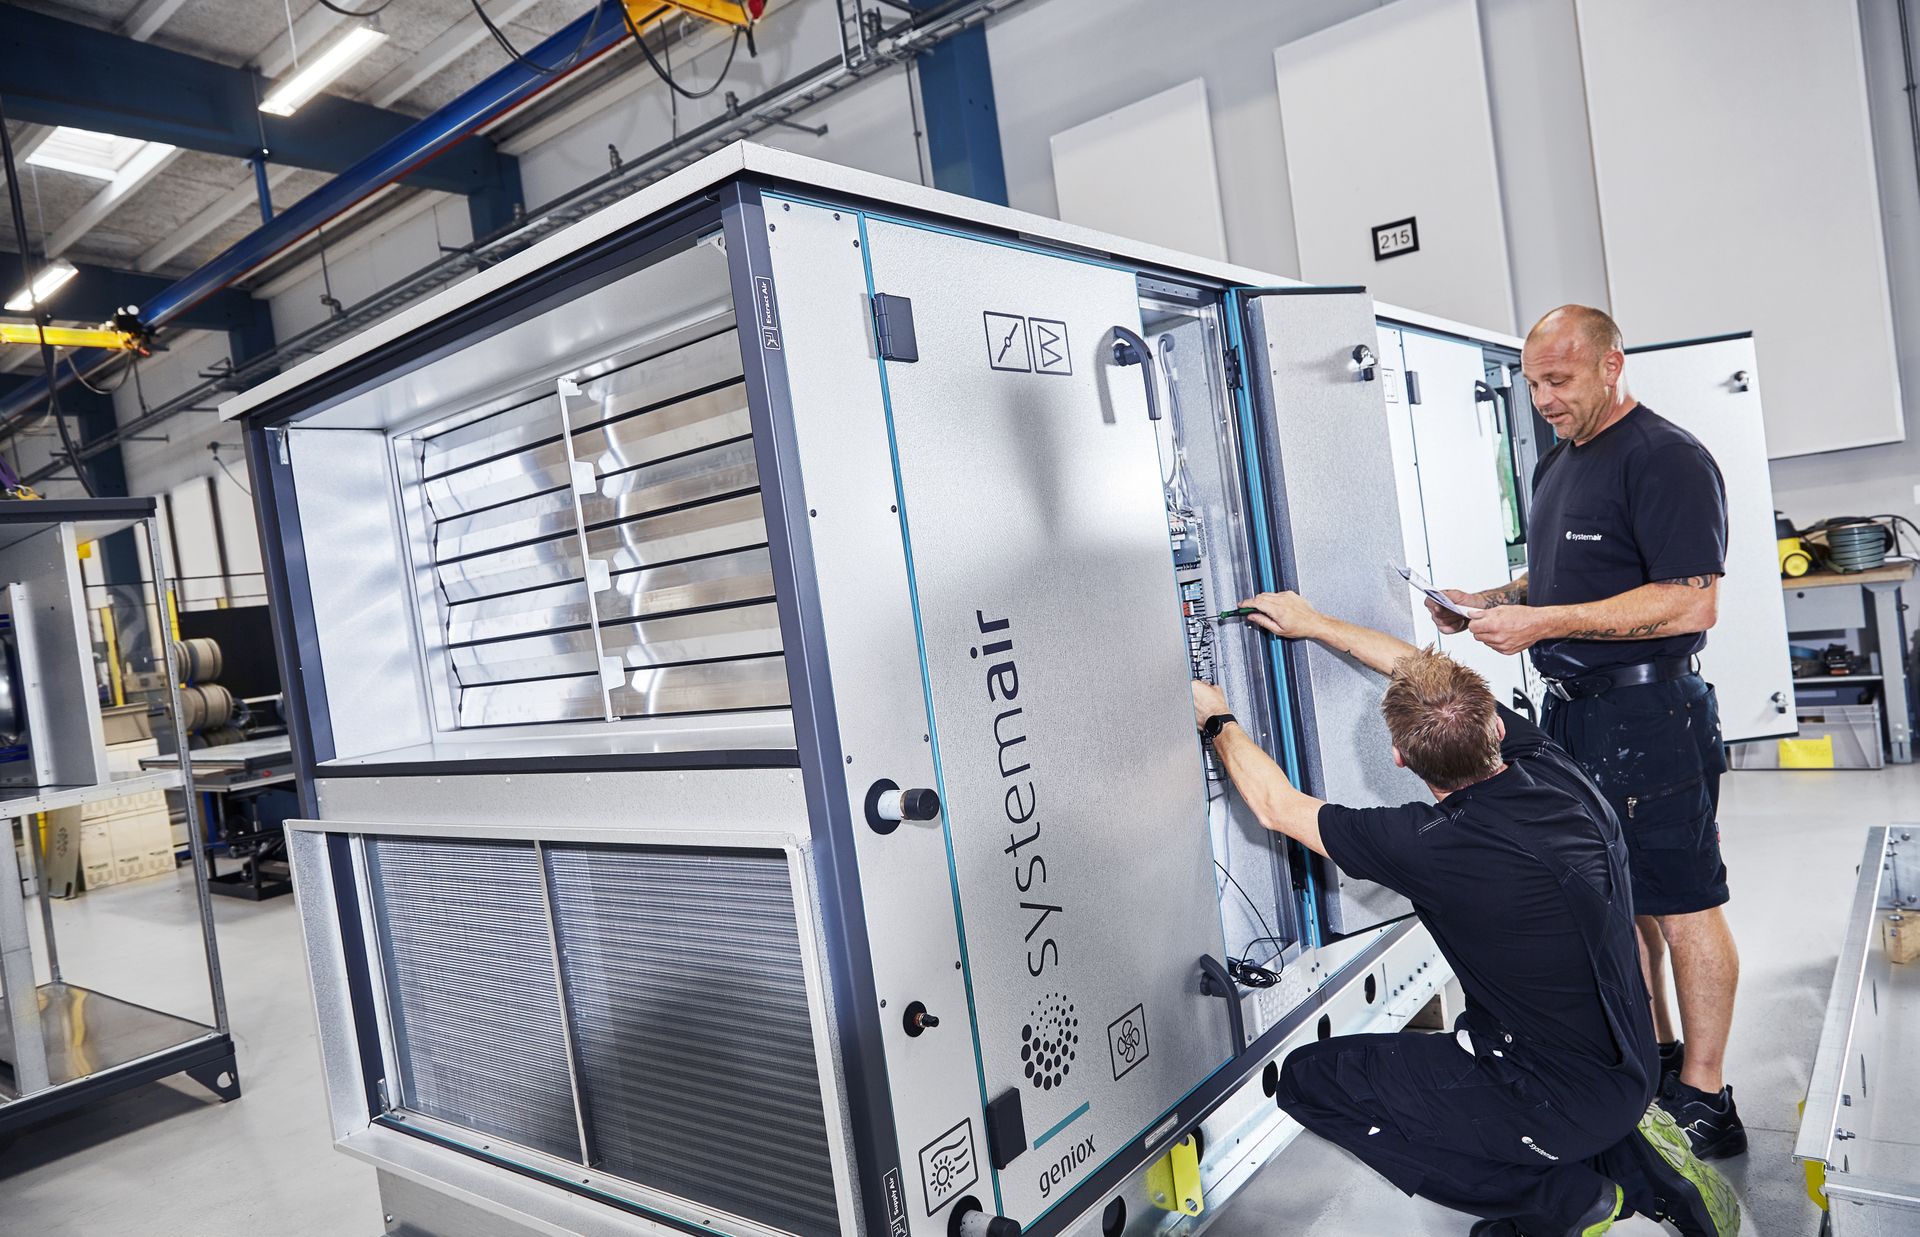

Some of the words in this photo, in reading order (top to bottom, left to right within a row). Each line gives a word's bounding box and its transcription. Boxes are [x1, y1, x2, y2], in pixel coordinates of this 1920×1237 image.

[1380, 229, 1410, 249] 215
[763, 295, 772, 324] Extract
[1572, 533, 1602, 541] systemair
[970, 609, 1063, 978] systemair
[1039, 1134, 1096, 1199] geniox
[891, 1190, 900, 1216] Supply
